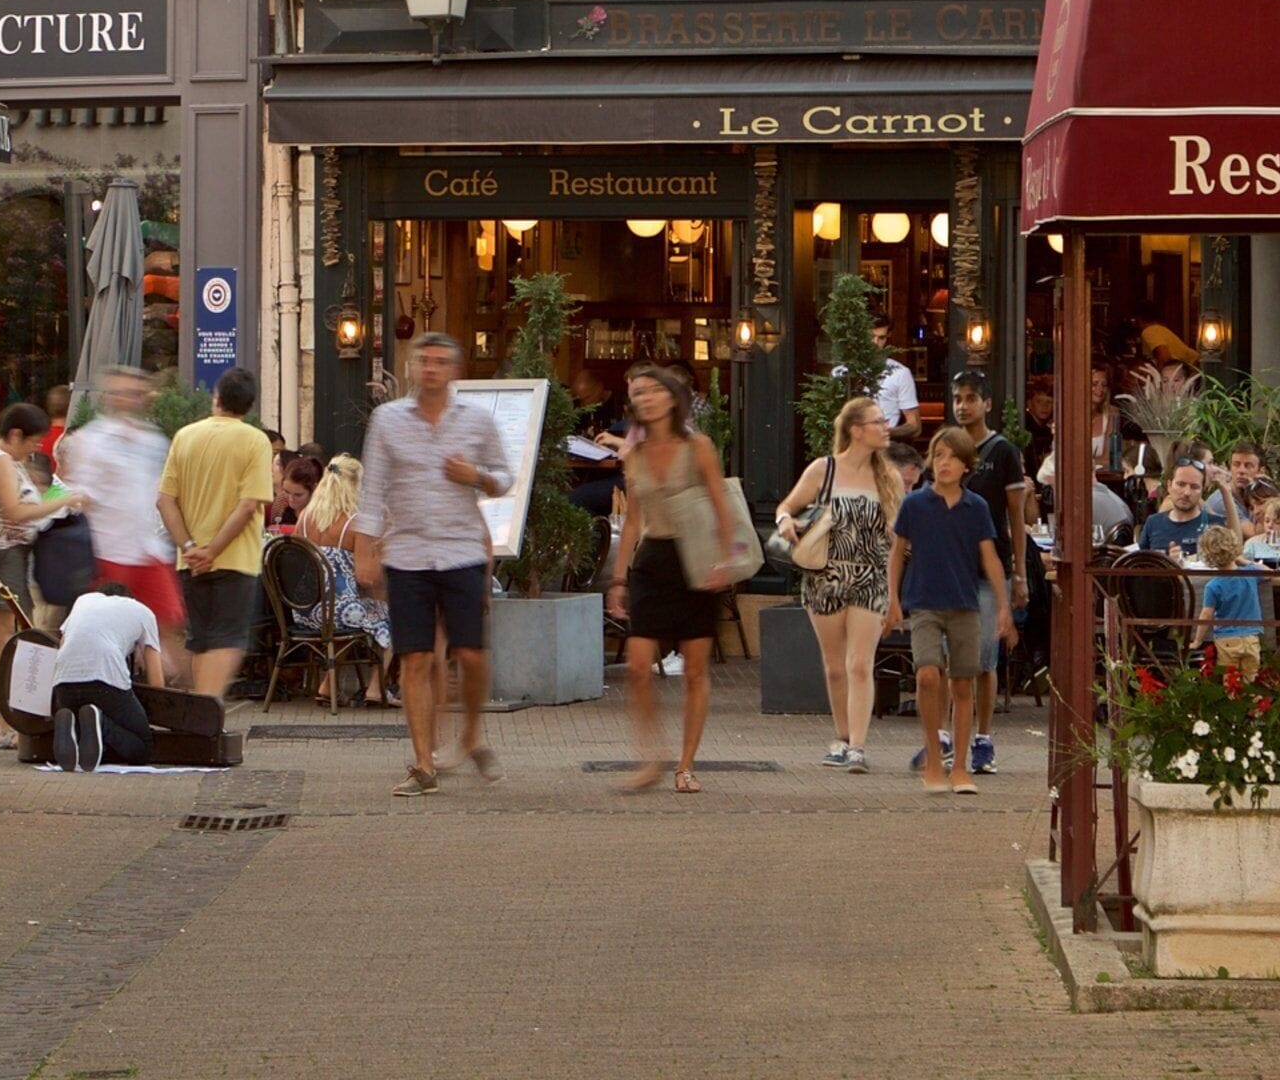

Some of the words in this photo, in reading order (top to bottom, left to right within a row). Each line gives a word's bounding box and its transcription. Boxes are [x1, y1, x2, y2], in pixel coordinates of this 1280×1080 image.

[607, 8, 843, 46] BRASSERIE
[863, 7, 912, 42] LE
[719, 107, 780, 136] Le
[802, 105, 986, 135] Carnot
[424, 168, 498, 198] Café
[549, 167, 718, 197] Restaurant
